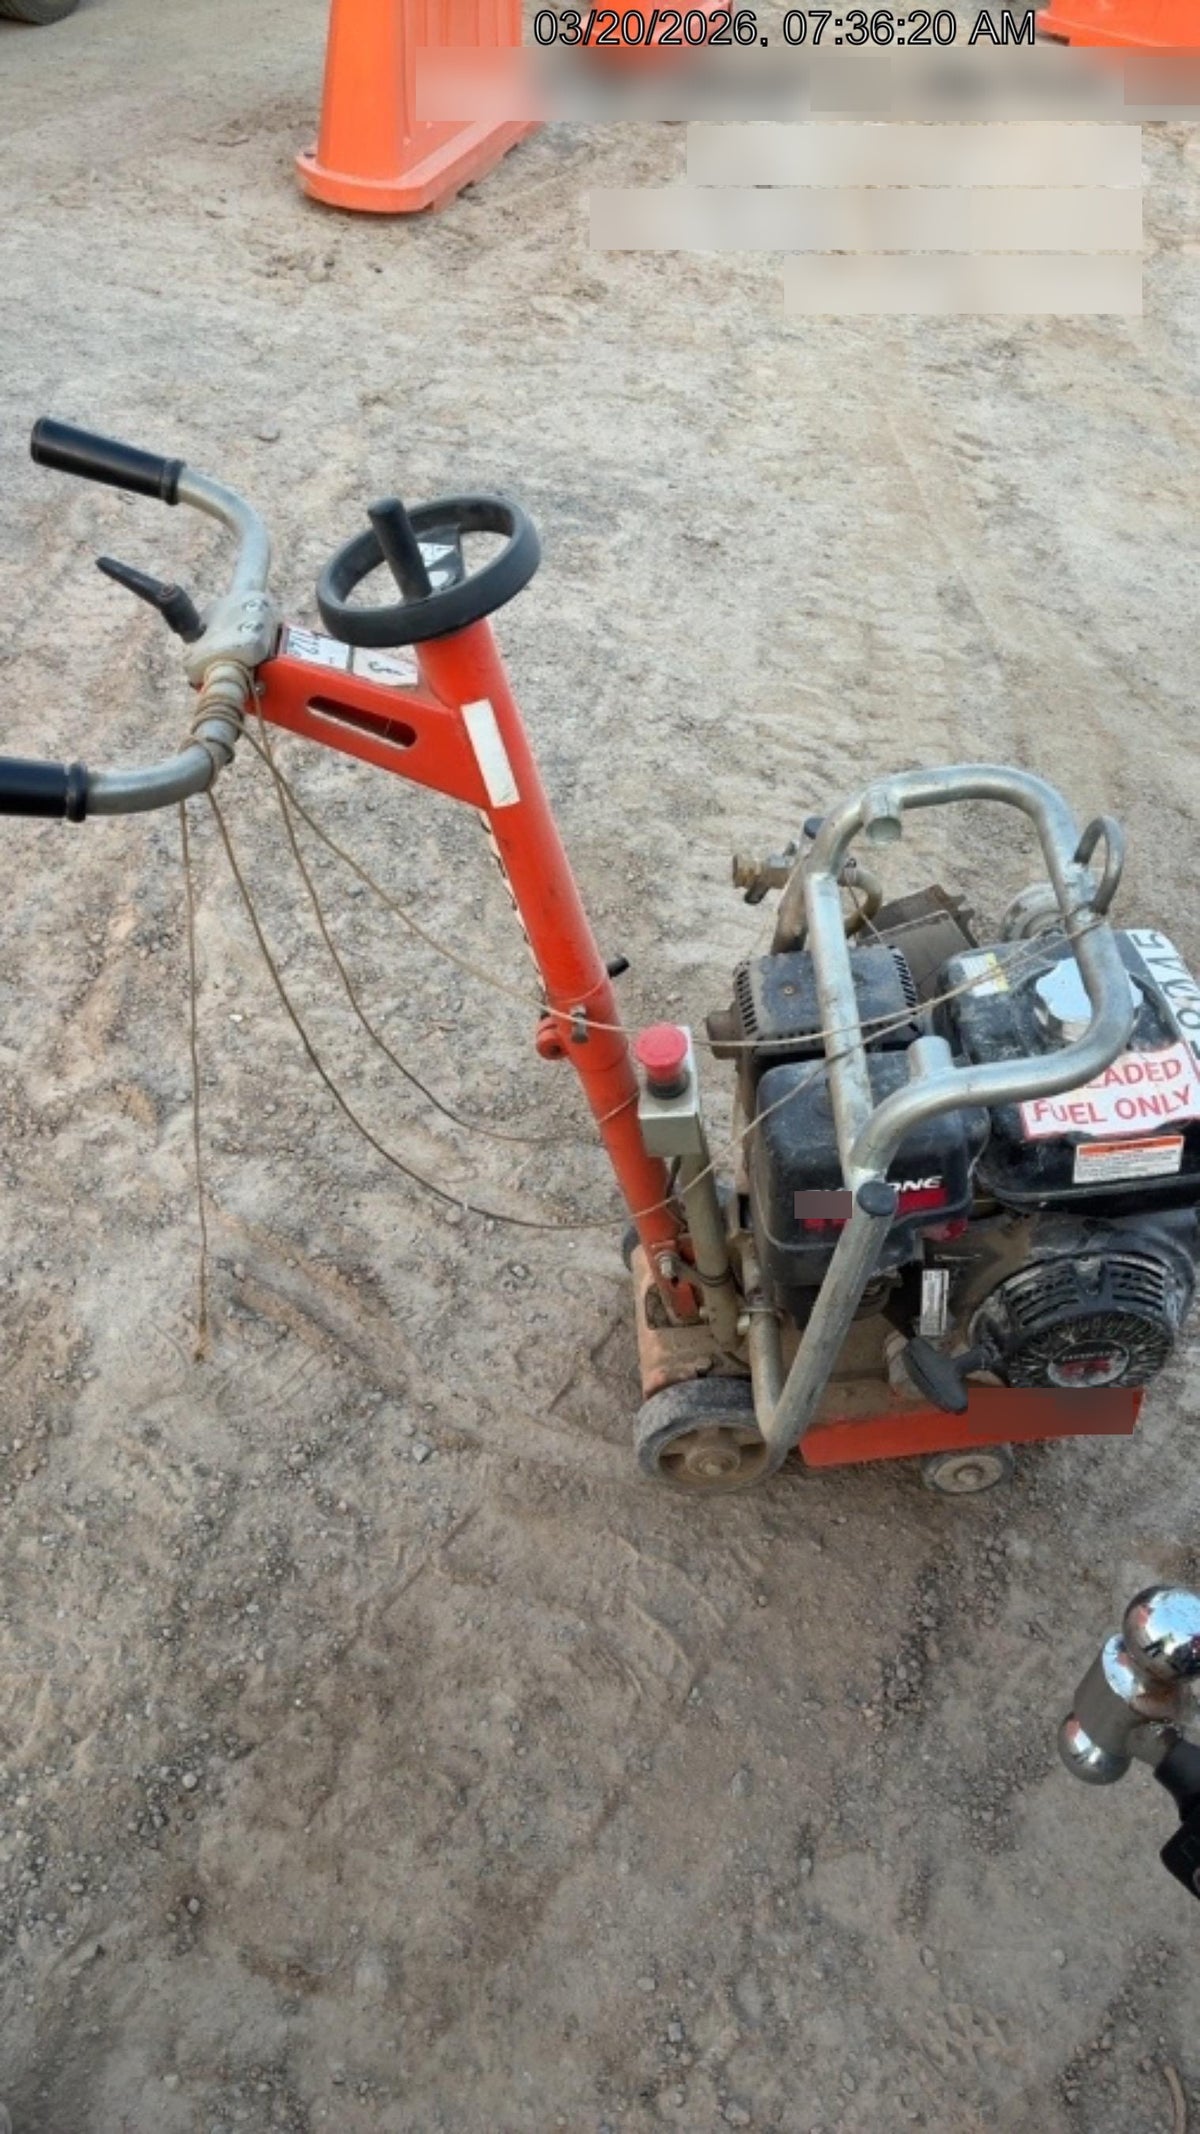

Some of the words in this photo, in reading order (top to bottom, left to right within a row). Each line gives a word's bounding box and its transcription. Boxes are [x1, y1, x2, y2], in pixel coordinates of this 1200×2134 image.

[1086, 1059, 1182, 1089] ADED
[1033, 1100, 1108, 1124] FUEL
[1114, 1084, 1191, 1120] ONLY
